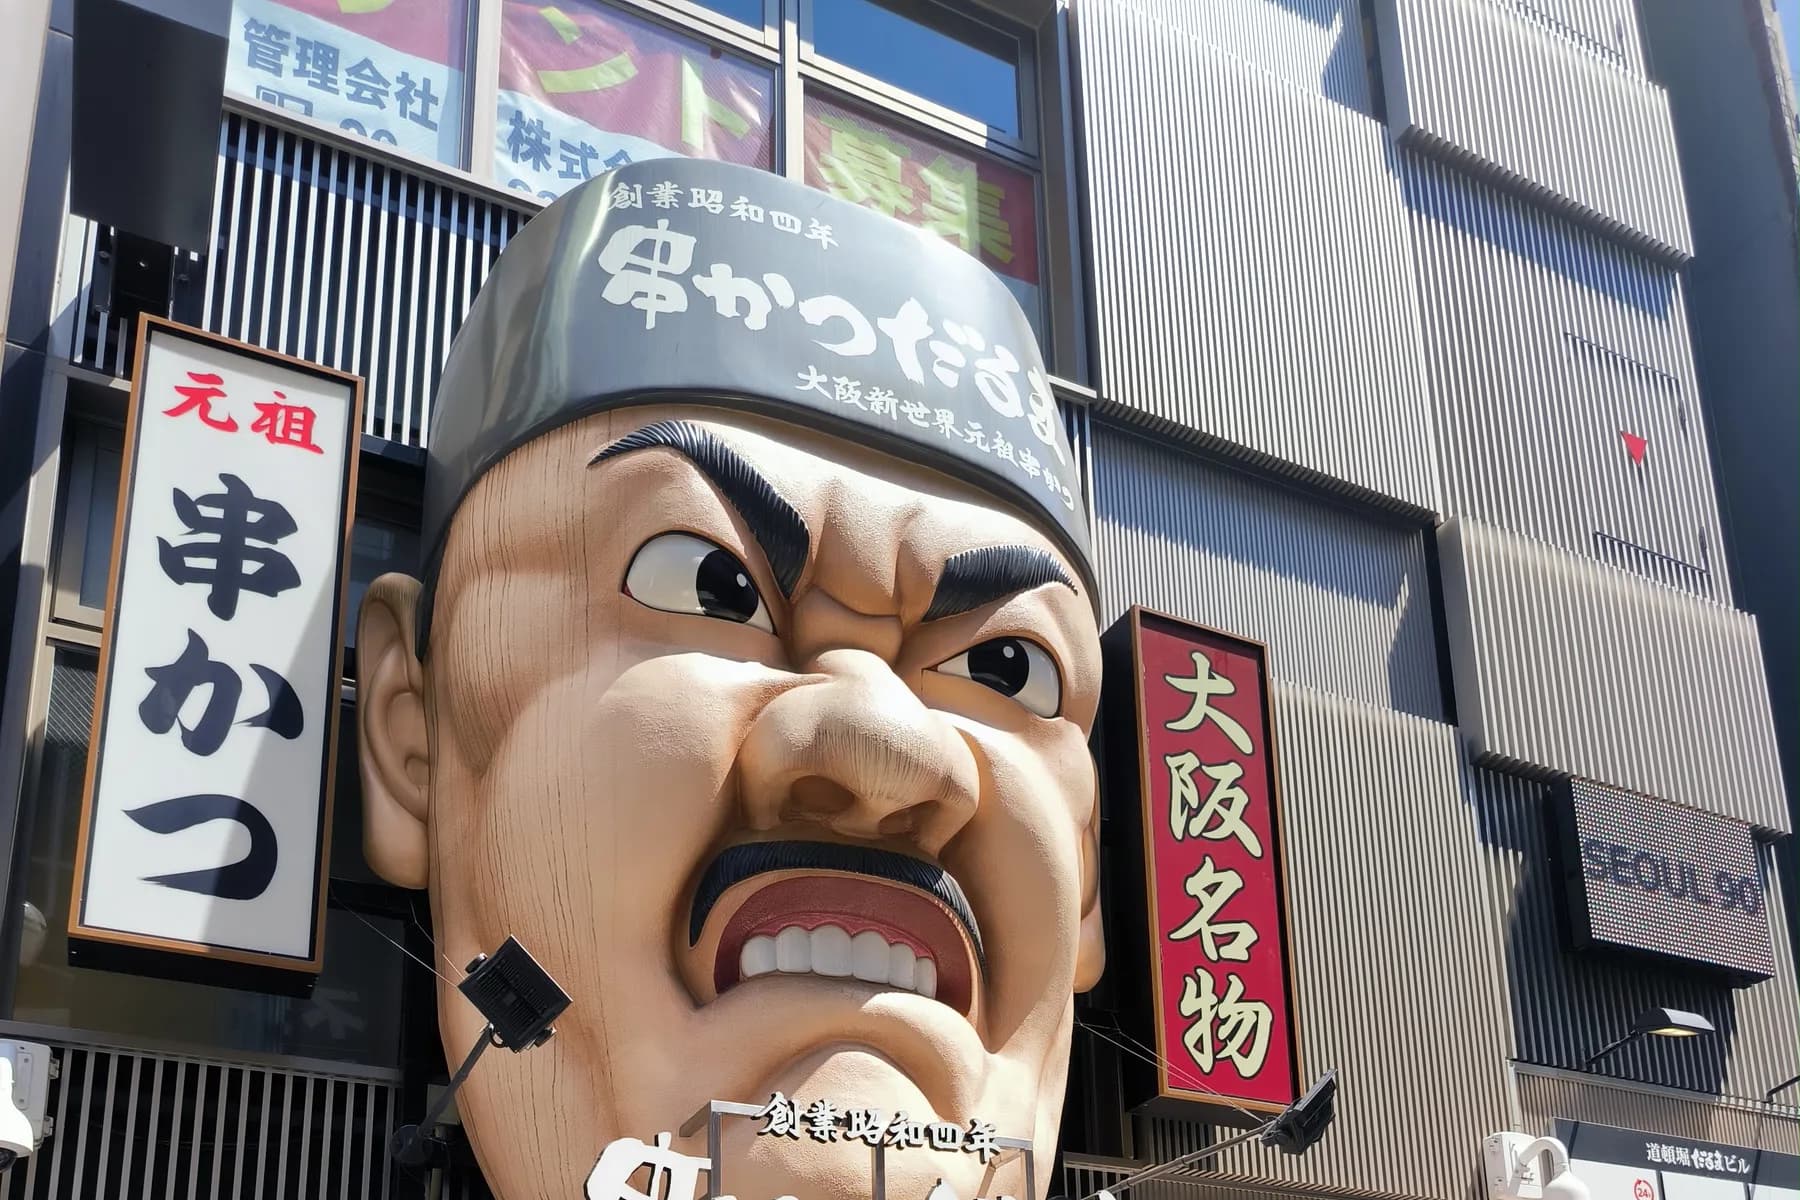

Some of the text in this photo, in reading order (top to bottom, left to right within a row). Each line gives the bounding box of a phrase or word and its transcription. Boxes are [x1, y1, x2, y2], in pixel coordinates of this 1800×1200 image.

[244, 17, 439, 131] 管理会社
[607, 181, 839, 251] 創業昭和四年
[598, 219, 1066, 467] 串かつだるま
[162, 371, 324, 455] 元祖
[796, 364, 1075, 511] 大阪新世界元祖串かつ
[120, 472, 304, 900] 串かつ
[1164, 651, 1273, 1079] 大阪名物
[1582, 837, 1714, 906] SEOUL
[751, 1092, 1002, 1160] 創業昭和四年
[1645, 1142, 1751, 1174] 道頓堀だるまビル
